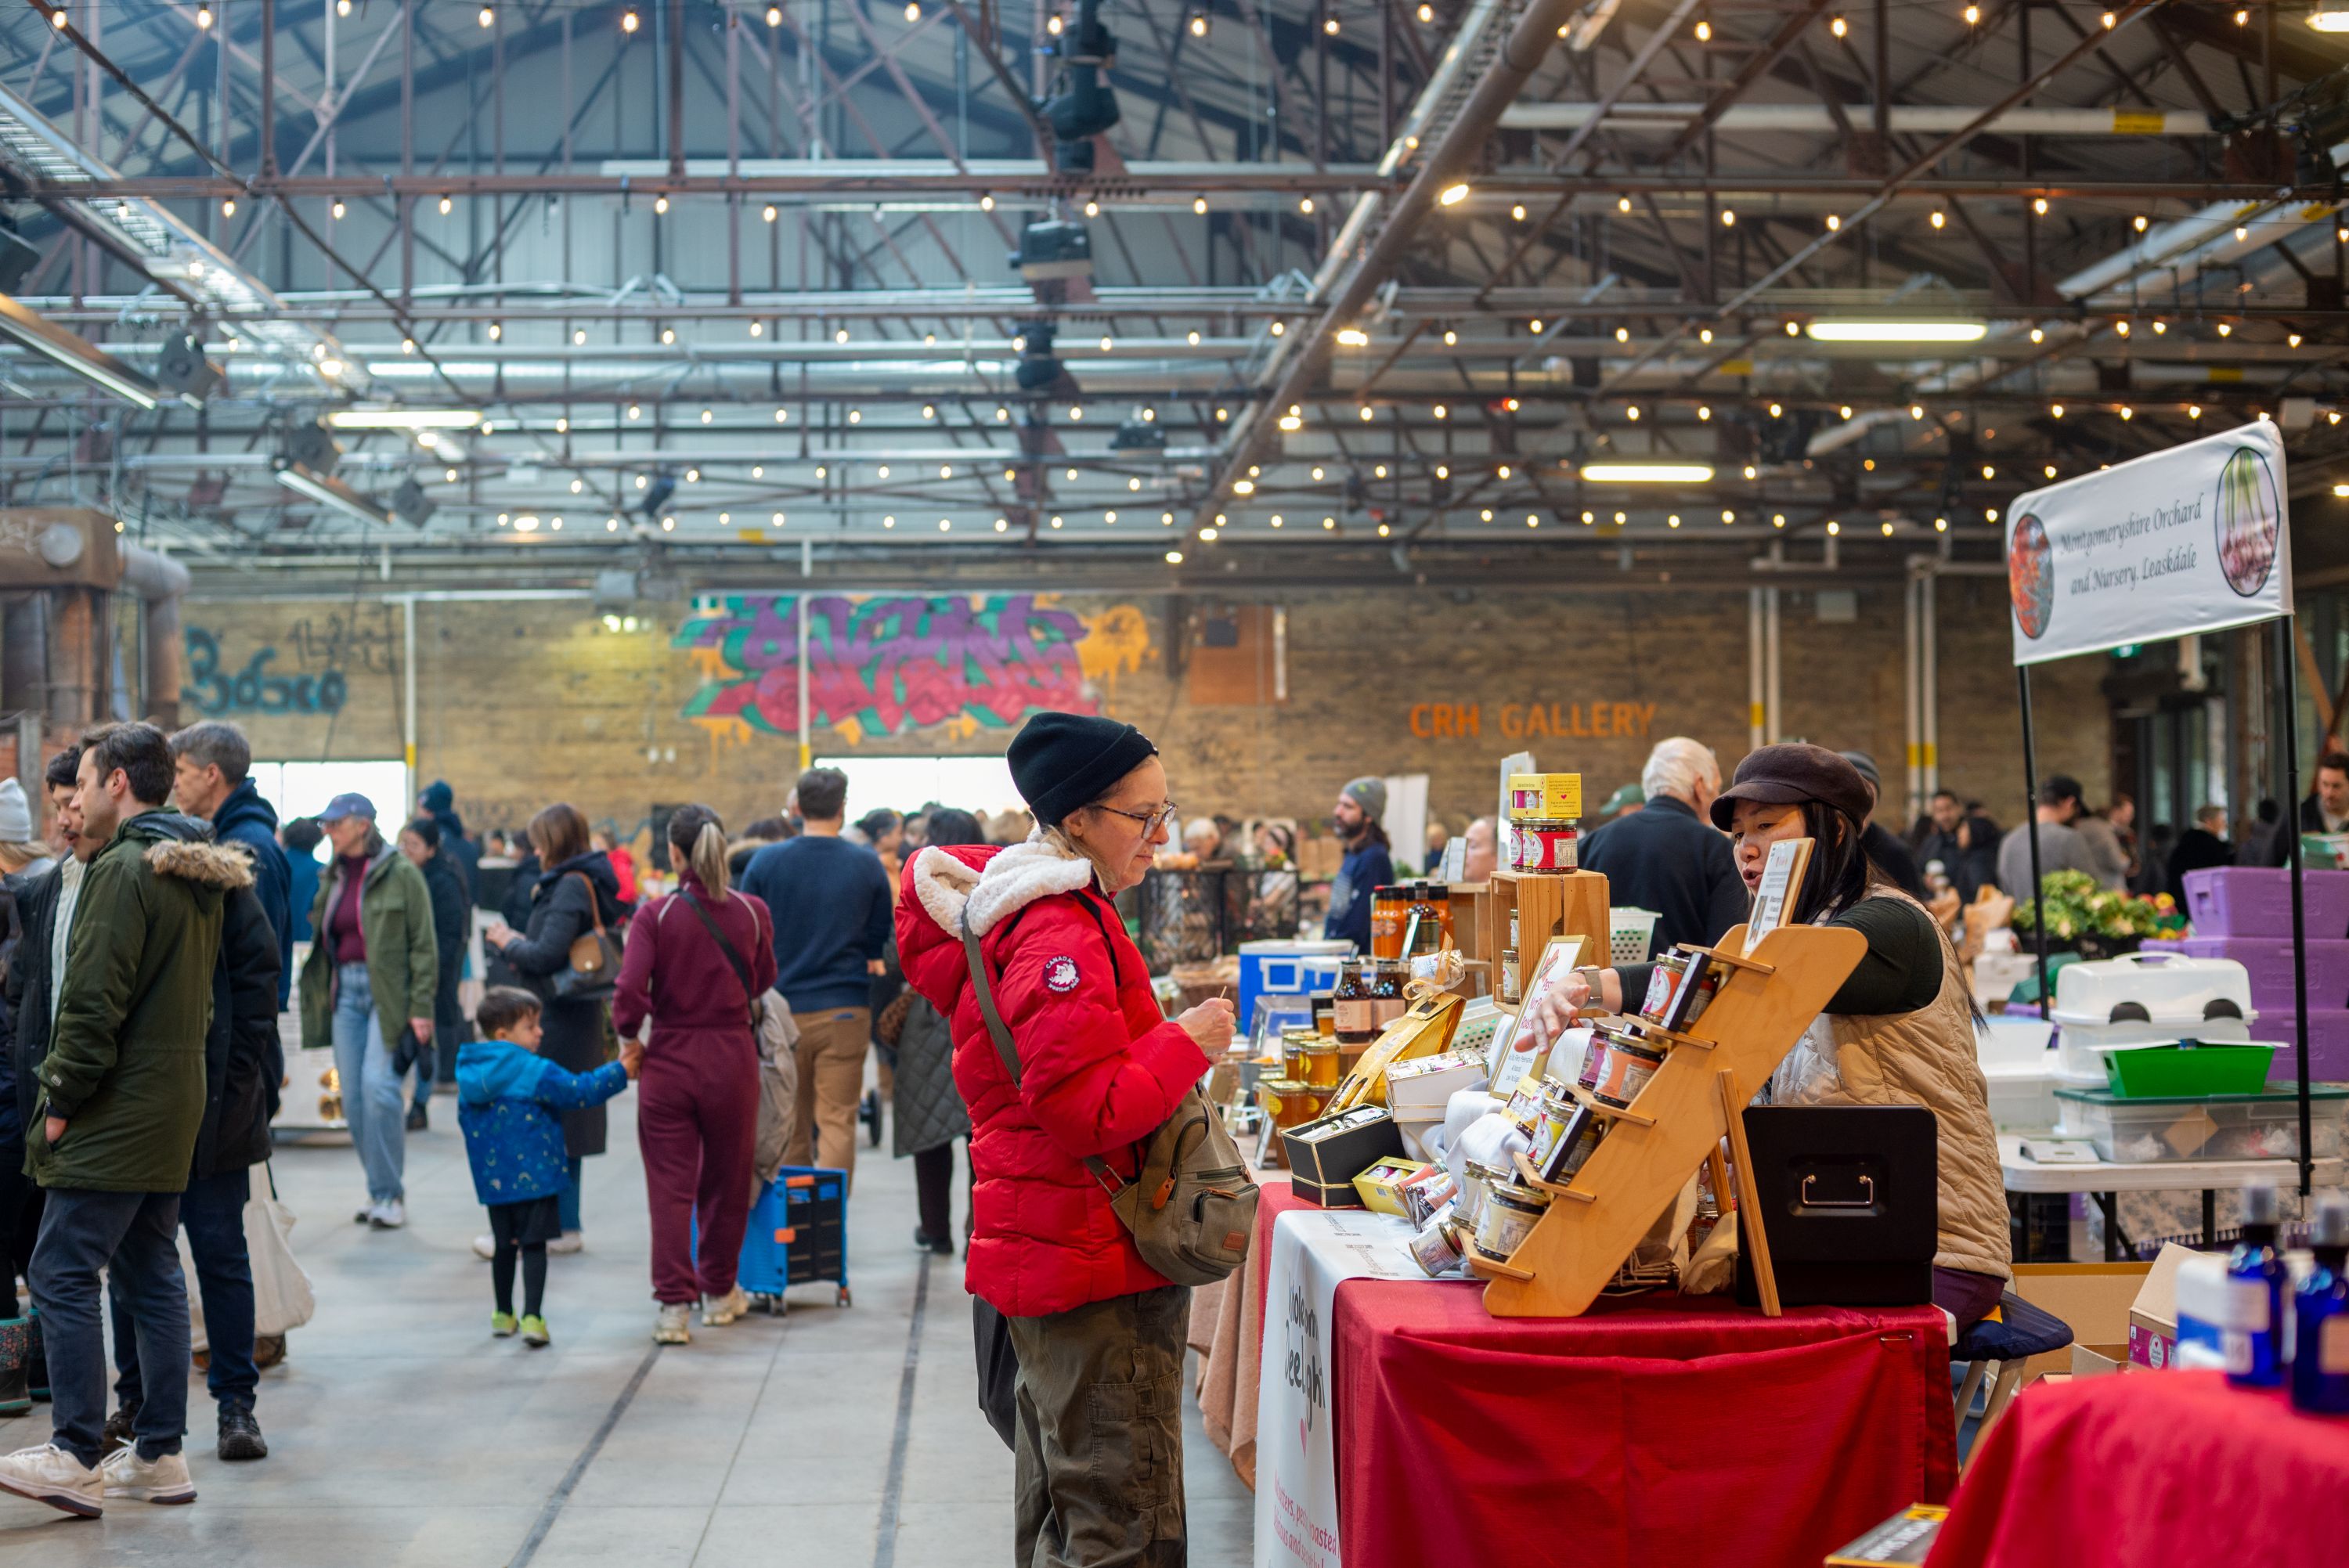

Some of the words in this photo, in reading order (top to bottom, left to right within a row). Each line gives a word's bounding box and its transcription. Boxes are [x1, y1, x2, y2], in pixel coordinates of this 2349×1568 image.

[2061, 512, 2151, 557] Montgomeryshire
[2154, 492, 2204, 531] Orchard
[2071, 567, 2092, 596] and
[2142, 542, 2197, 580] Leaskdale
[1410, 701, 1480, 739] CRH
[1499, 701, 1657, 740] GALLERY
[1288, 1533, 1301, 1558] and
